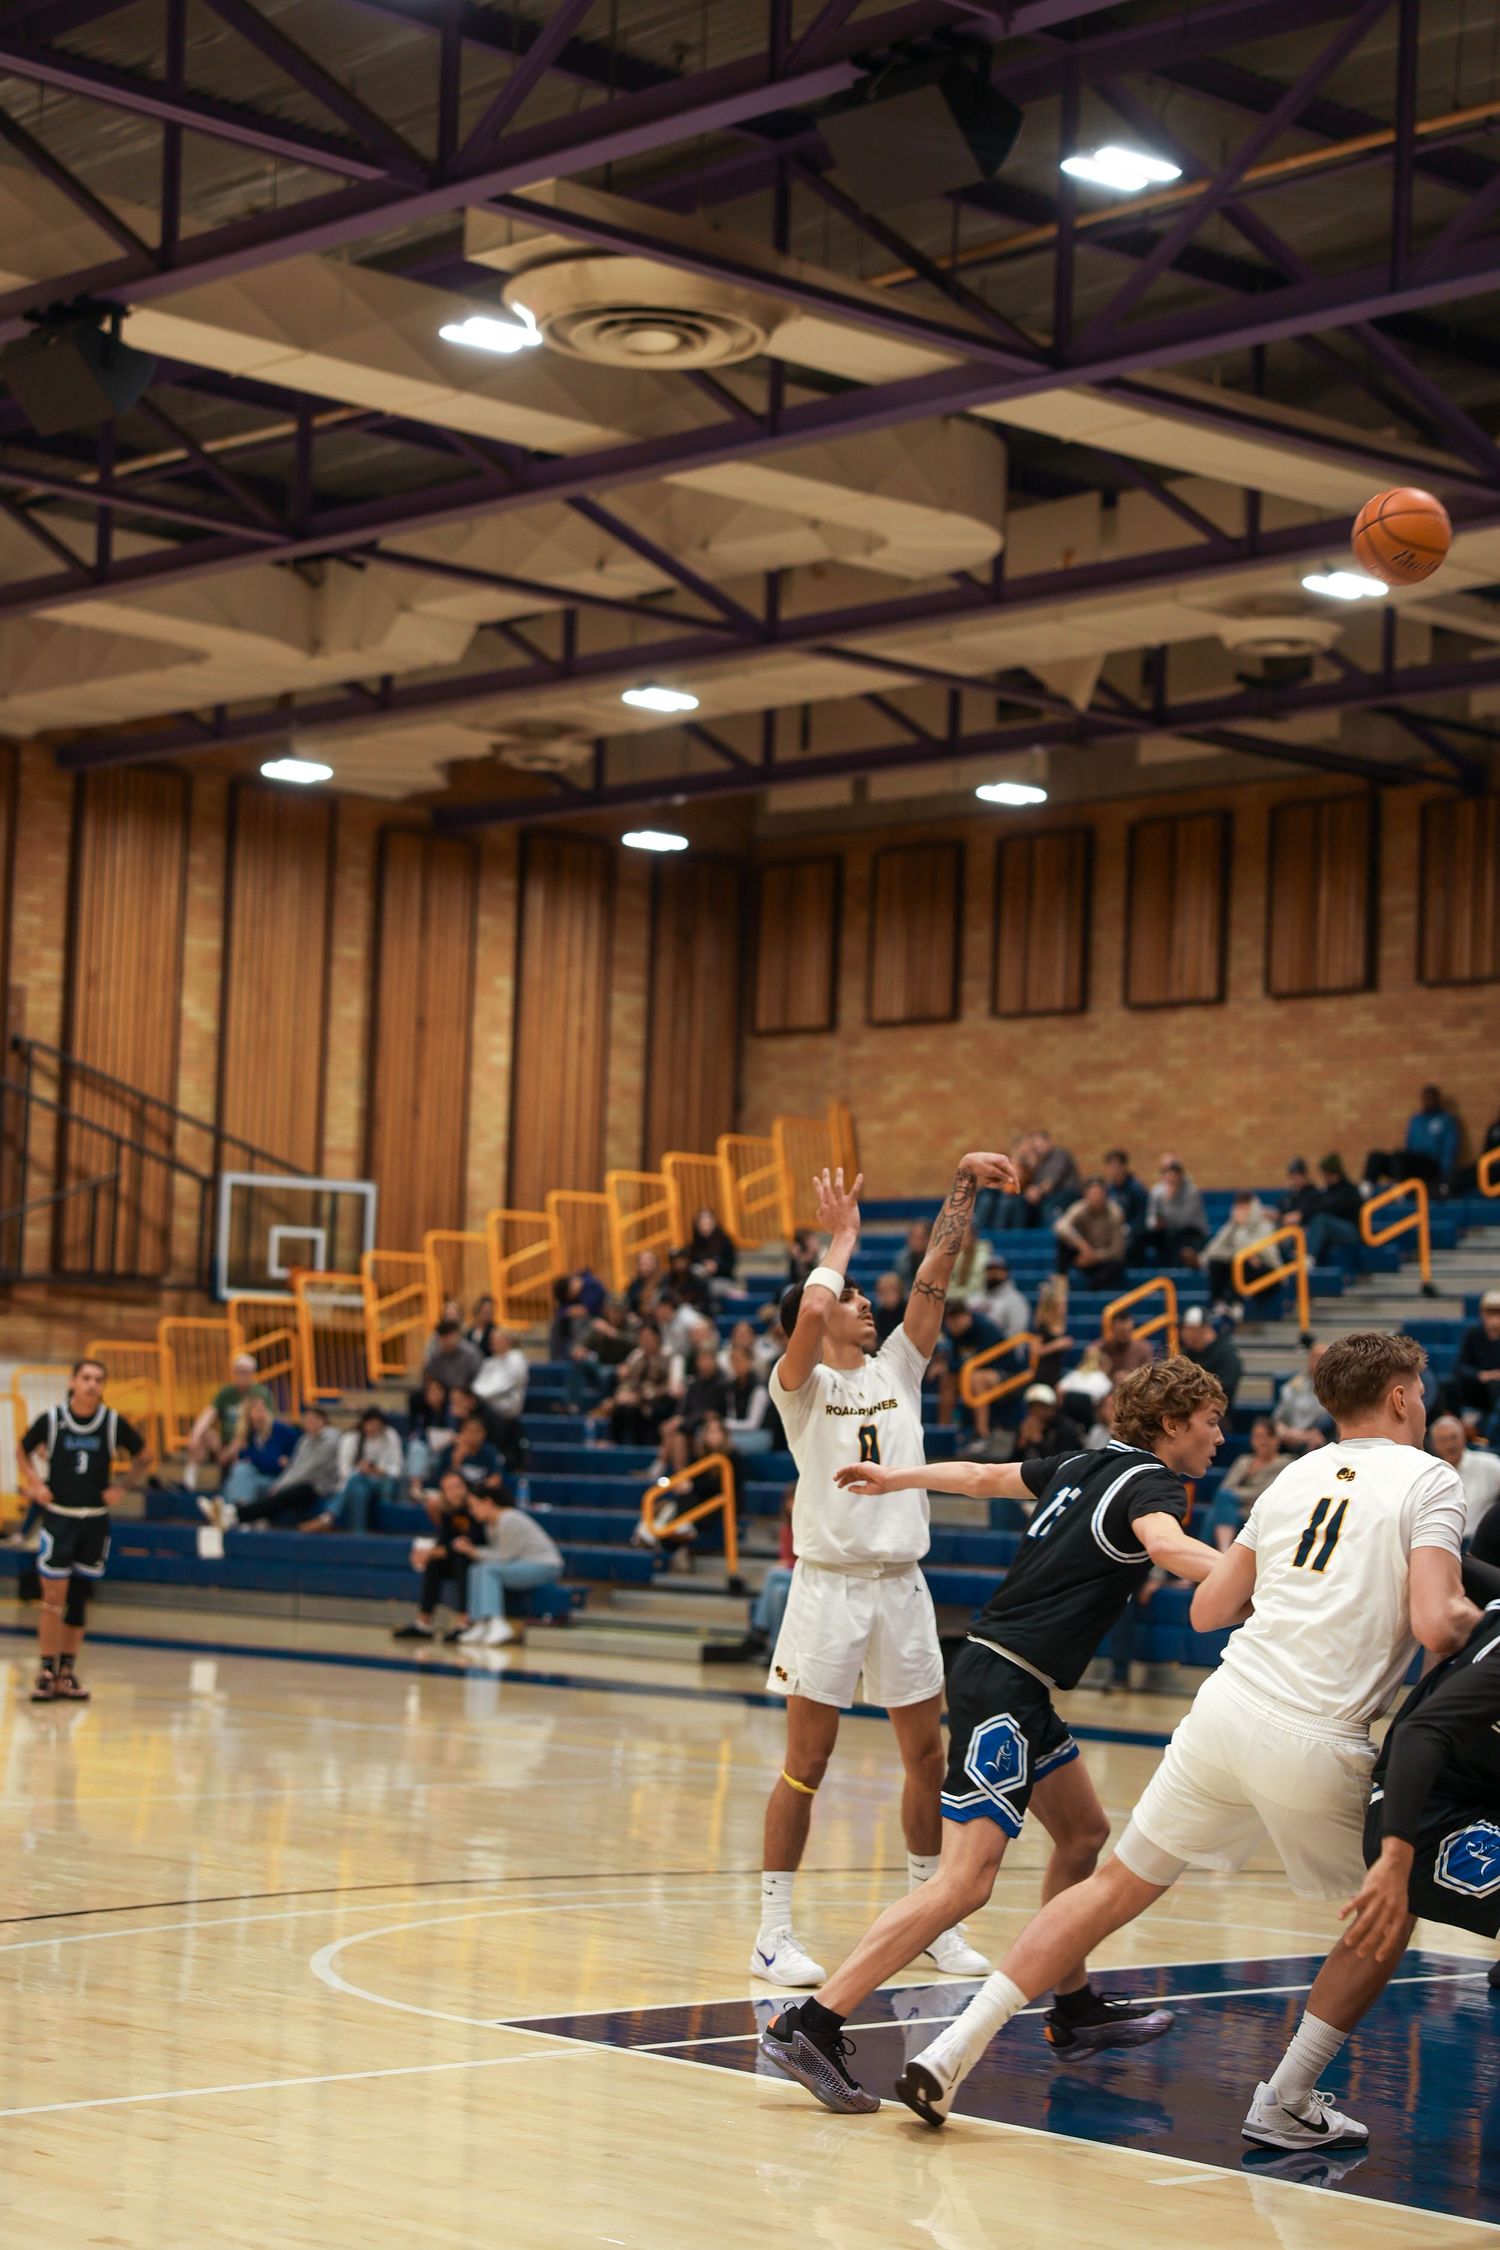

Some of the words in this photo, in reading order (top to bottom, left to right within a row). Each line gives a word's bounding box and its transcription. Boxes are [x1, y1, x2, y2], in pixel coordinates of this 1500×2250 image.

[826, 1399, 898, 1417] ROADRNES
[858, 1424, 881, 1465] 0
[75, 1450, 89, 1474] 3
[1291, 1497, 1350, 1574] 11
